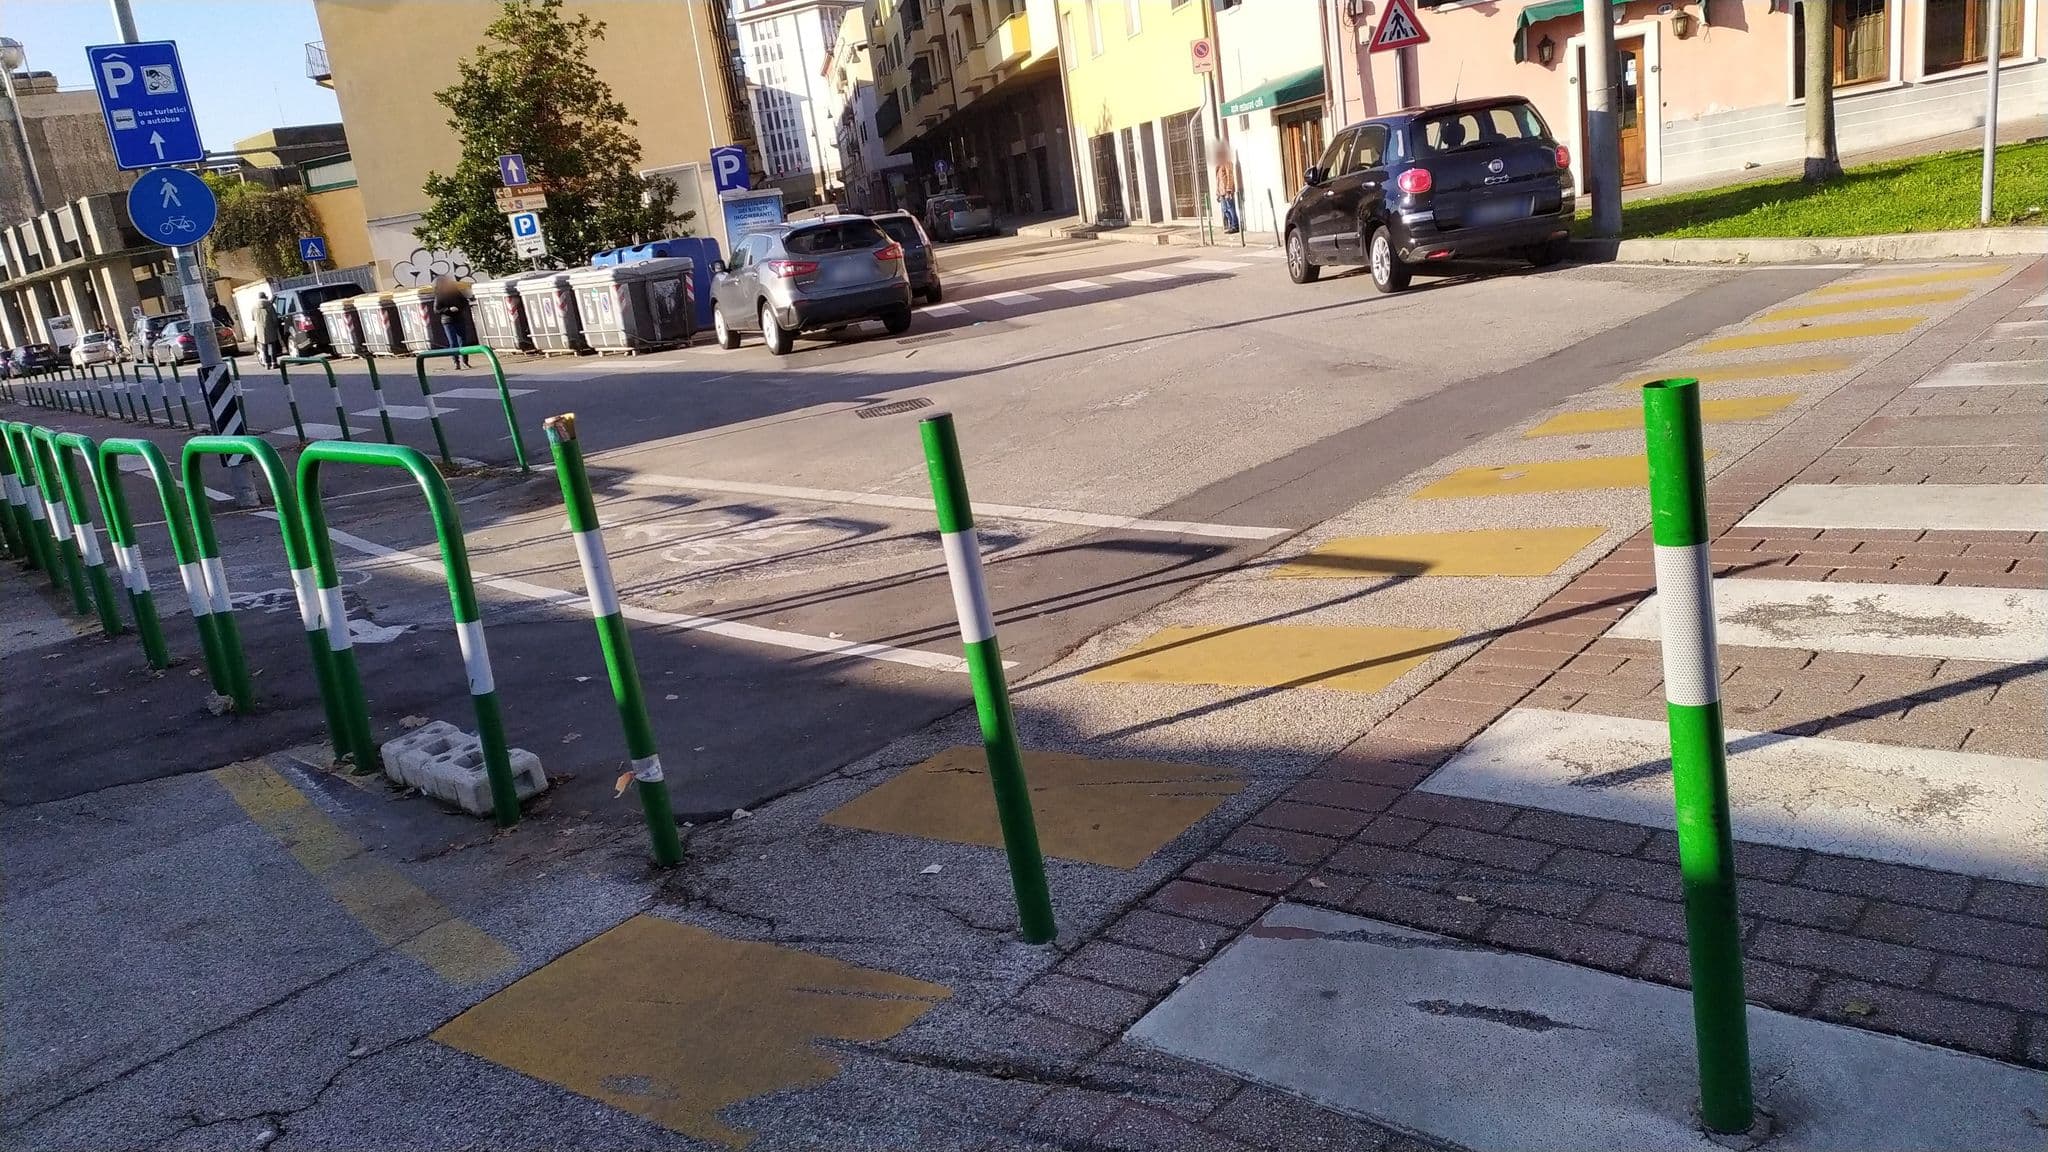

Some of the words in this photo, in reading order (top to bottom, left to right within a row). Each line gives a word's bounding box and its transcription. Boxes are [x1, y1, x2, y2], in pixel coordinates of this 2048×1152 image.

[101, 61, 134, 99] P
[154, 106, 187, 115] turistici
[147, 116, 180, 125] autobus
[717, 154, 741, 186] P
[519, 217, 531, 234] P
